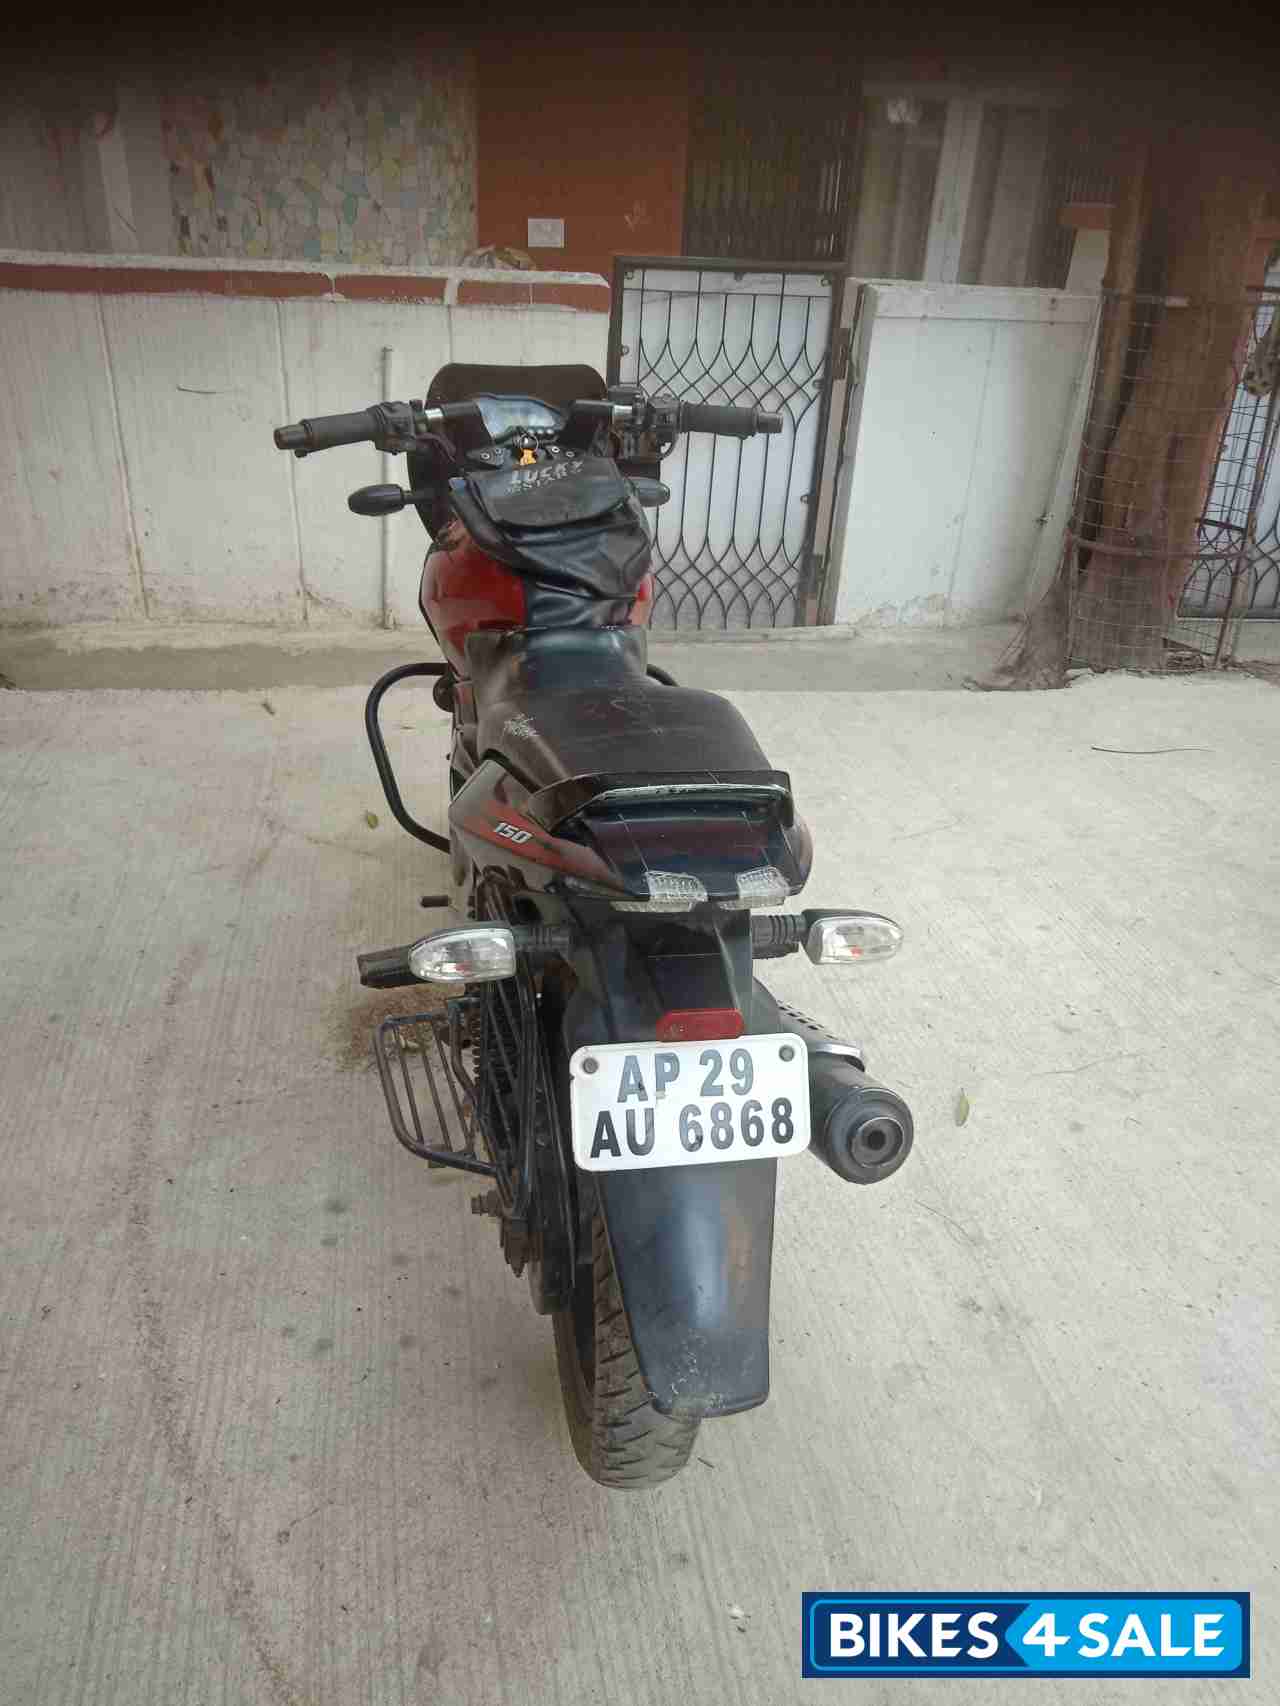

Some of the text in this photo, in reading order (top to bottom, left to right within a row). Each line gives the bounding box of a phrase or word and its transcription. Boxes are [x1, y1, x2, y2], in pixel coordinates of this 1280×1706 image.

[493, 821, 534, 845] 150
[617, 1048, 754, 1103] AP 29
[590, 1097, 795, 1159] AU 6868
